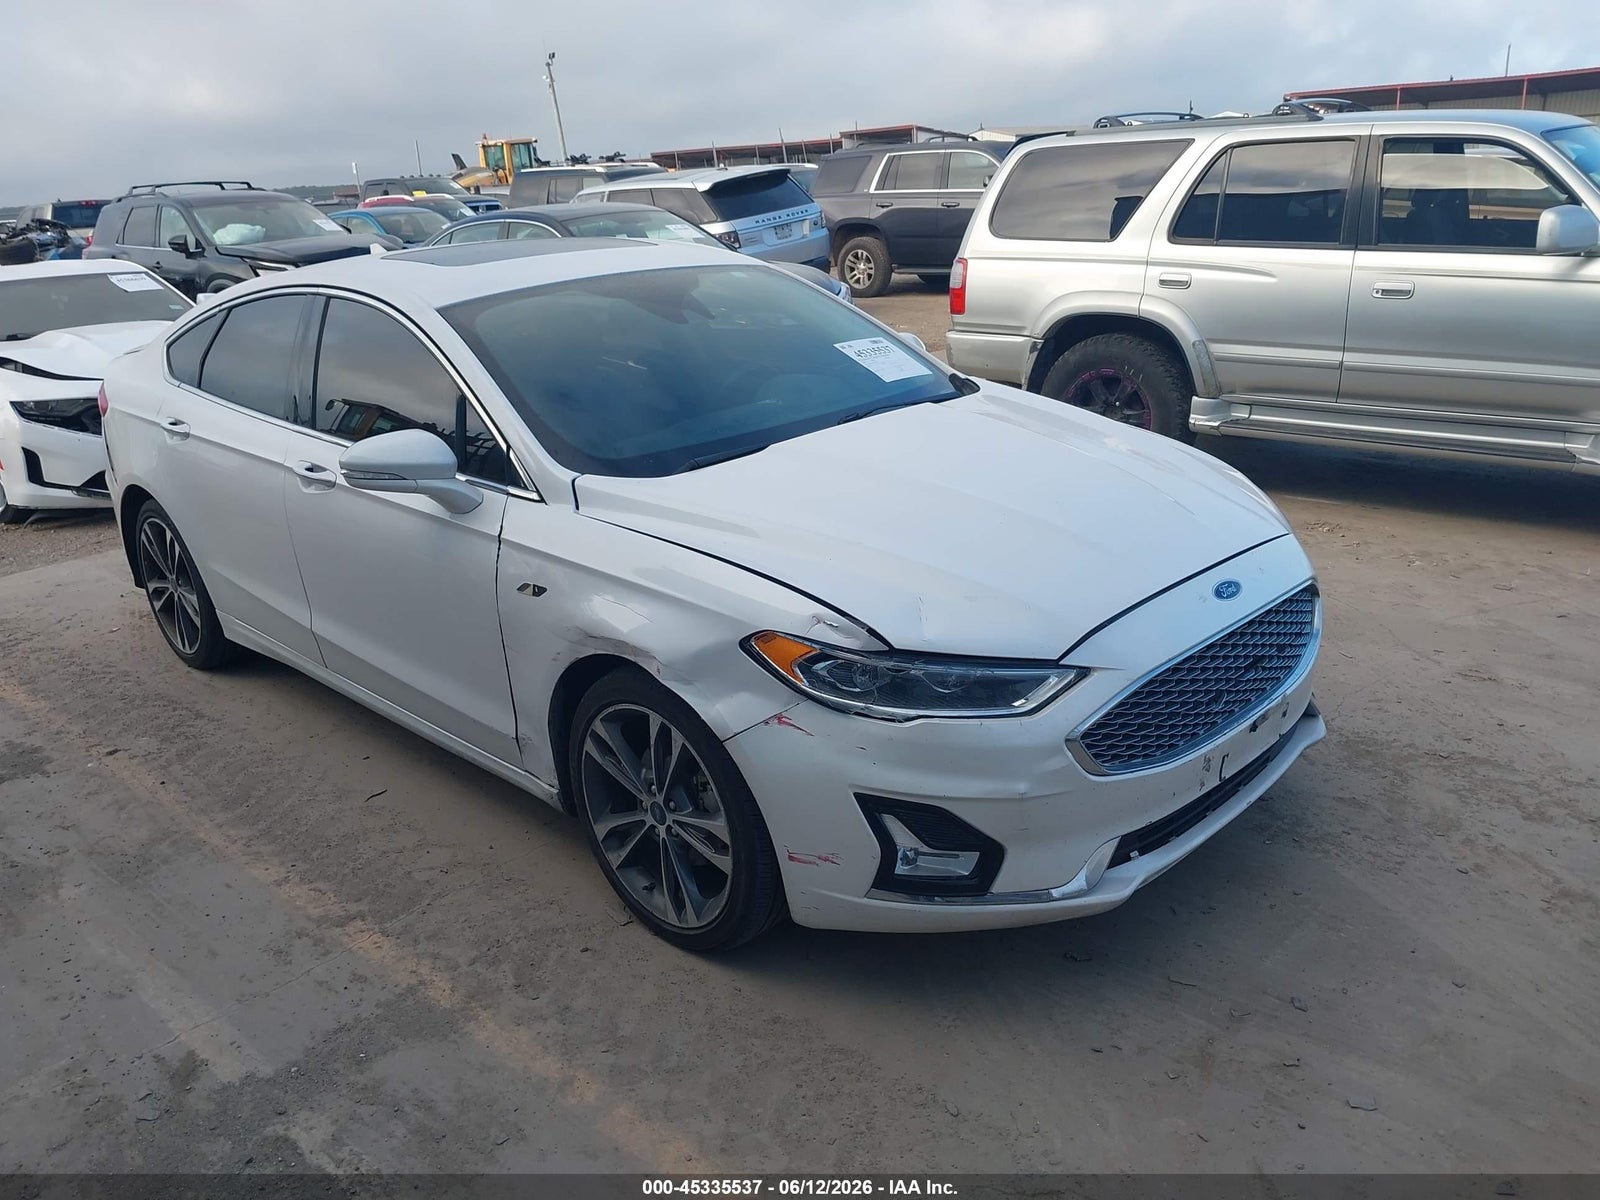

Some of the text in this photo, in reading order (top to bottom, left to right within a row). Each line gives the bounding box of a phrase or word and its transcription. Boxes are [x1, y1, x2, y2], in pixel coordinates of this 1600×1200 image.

[755, 209, 808, 224] RANGE ROVER
[854, 345, 895, 358] 45335537
[1219, 583, 1237, 597] Ford
